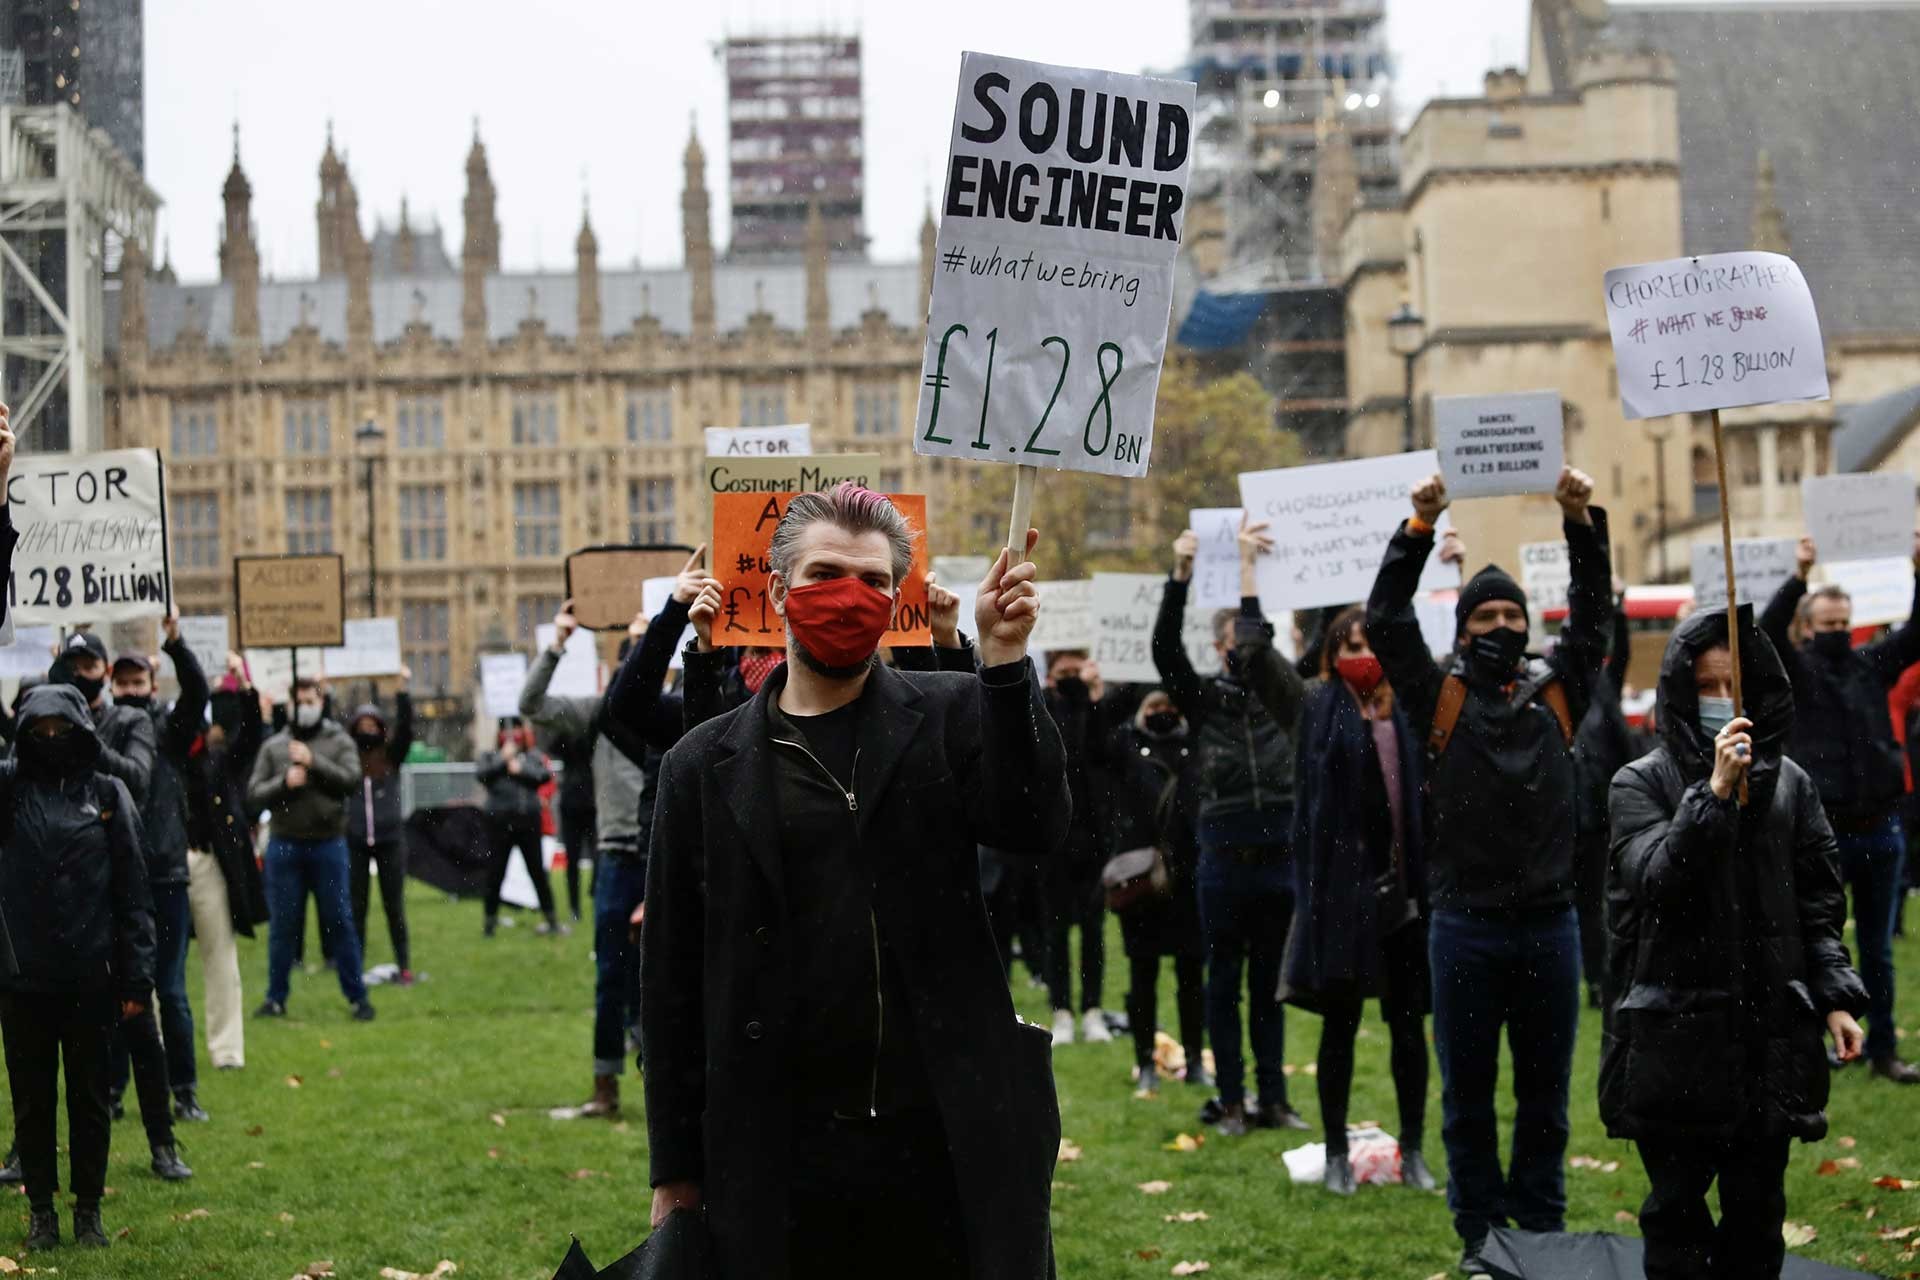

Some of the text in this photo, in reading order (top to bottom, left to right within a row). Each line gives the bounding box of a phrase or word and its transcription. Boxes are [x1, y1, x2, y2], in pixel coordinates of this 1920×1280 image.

[962, 72, 1190, 172] SOUND
[946, 155, 1183, 243] ENGINEER
[943, 245, 1140, 307] #whatwebring
[1609, 263, 1796, 309] CHOREOGRAPHER
[1656, 312, 1697, 335] WHAT
[1704, 310, 1724, 328] WE
[1650, 347, 1795, 390] £1.28 BILLION
[727, 438, 790, 454] ACTOR
[1498, 459, 1540, 473] BILLION
